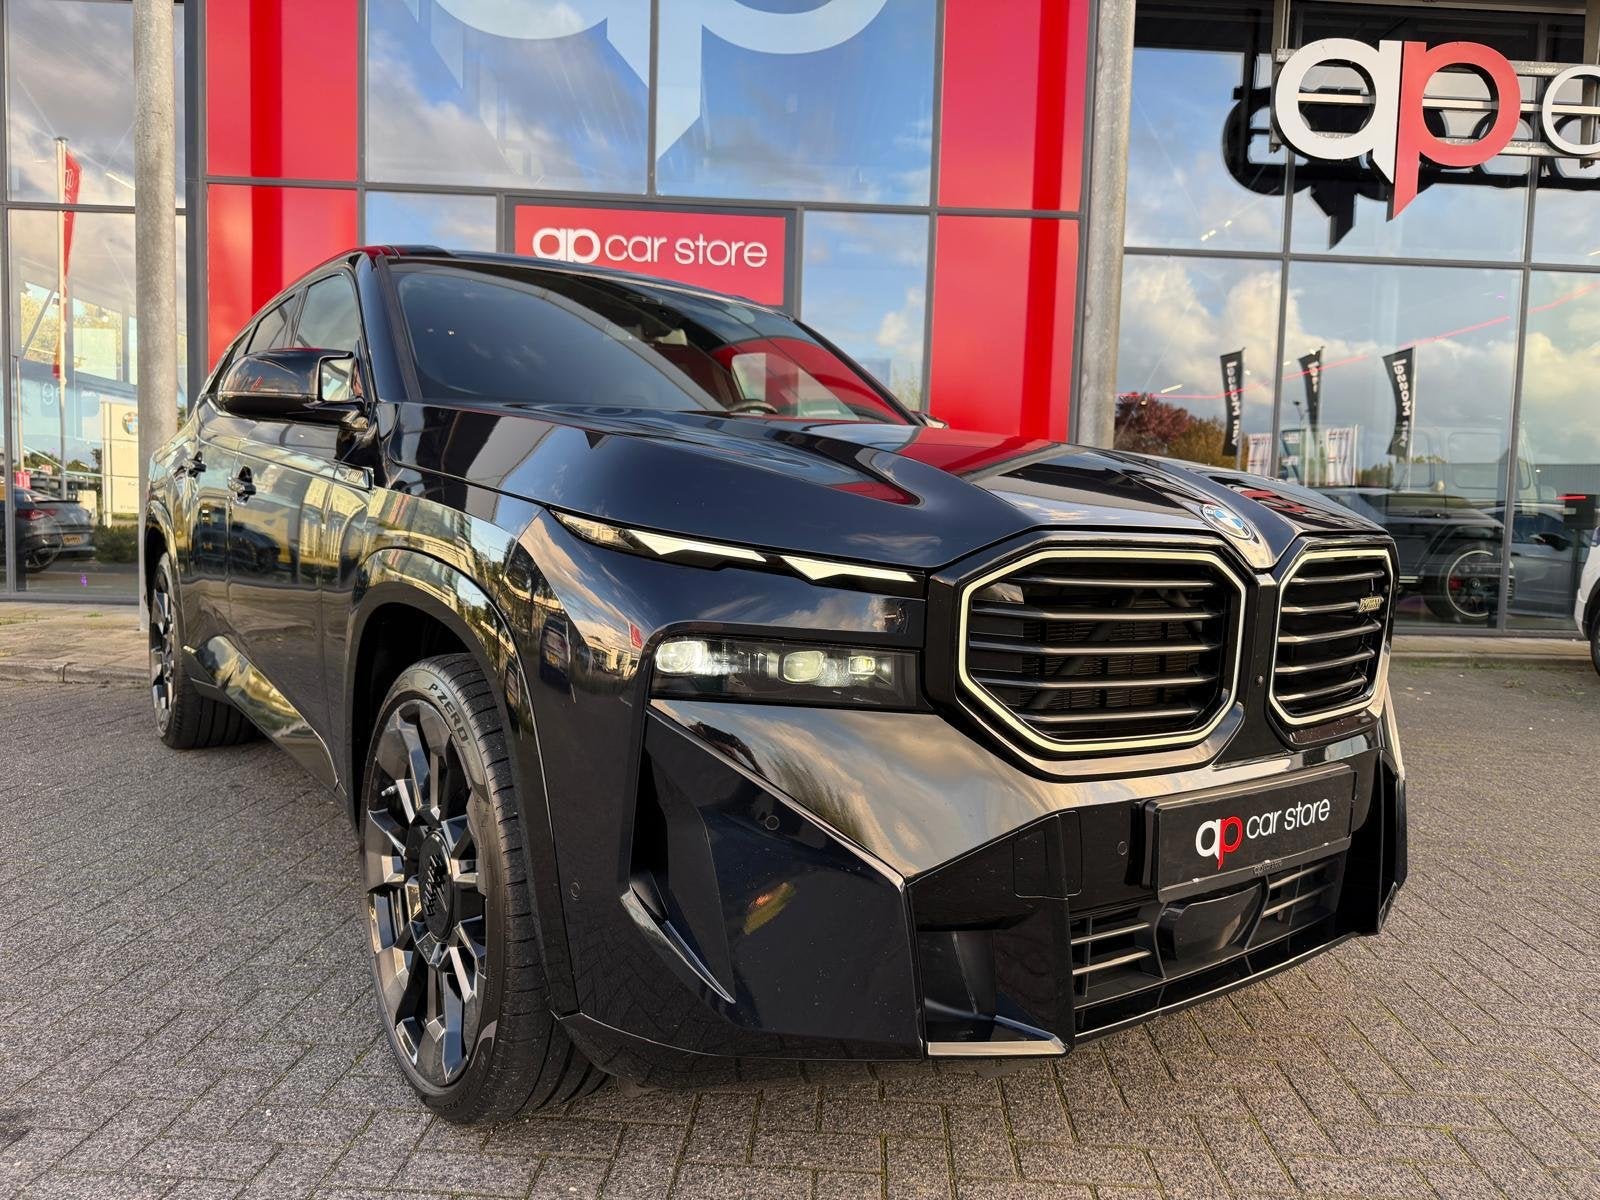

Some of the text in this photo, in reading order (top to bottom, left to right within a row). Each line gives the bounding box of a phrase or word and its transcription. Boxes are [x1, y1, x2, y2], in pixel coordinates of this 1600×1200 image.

[1275, 38, 1521, 219] ap
[532, 227, 768, 268] ap car store
[1195, 816, 1243, 871] ap
[1246, 810, 1282, 839] car
[1284, 798, 1330, 831] store
